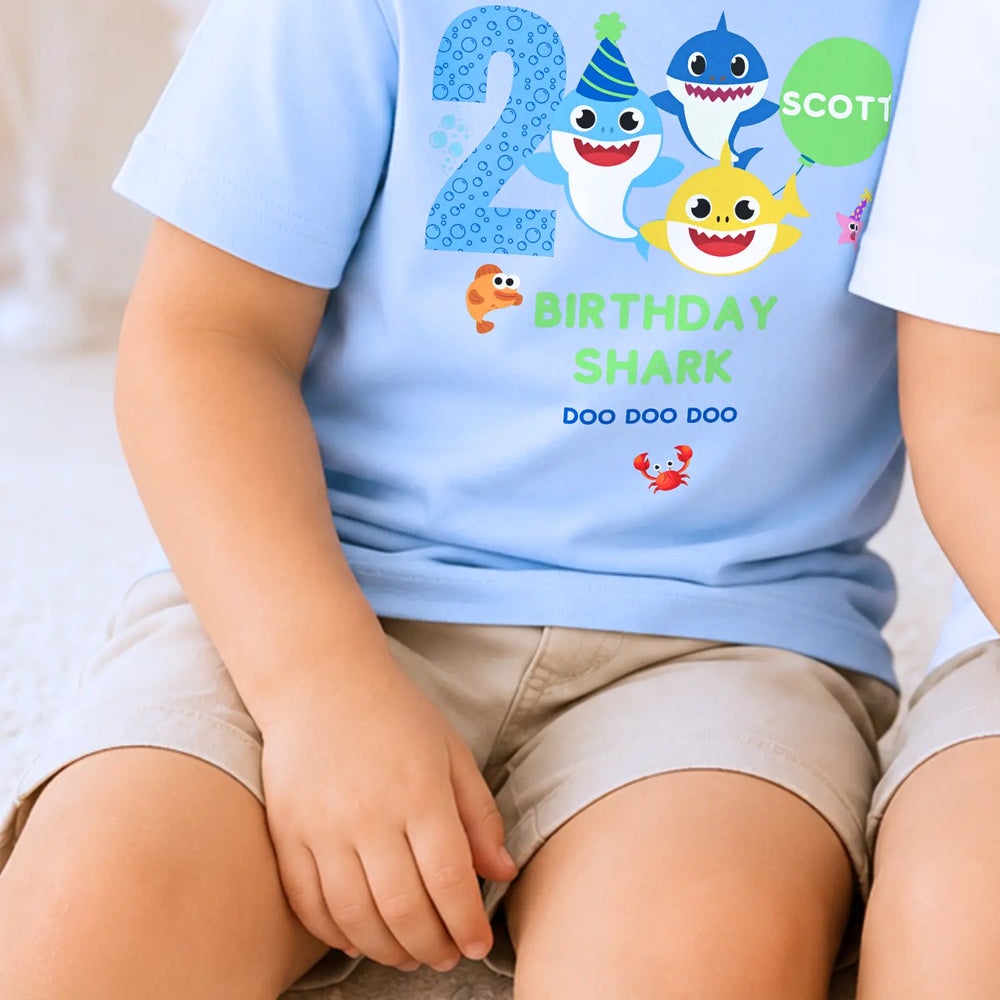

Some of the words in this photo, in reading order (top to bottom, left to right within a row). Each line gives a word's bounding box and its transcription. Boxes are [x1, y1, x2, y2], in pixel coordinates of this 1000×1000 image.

[782, 91, 891, 122] SCOTT
[425, 5, 567, 257] 2
[533, 292, 778, 332] BIRTHDAY
[574, 349, 733, 386] SHARK
[563, 407, 616, 425] DOO
[625, 407, 677, 424] DOO
[687, 406, 738, 423] DOO
